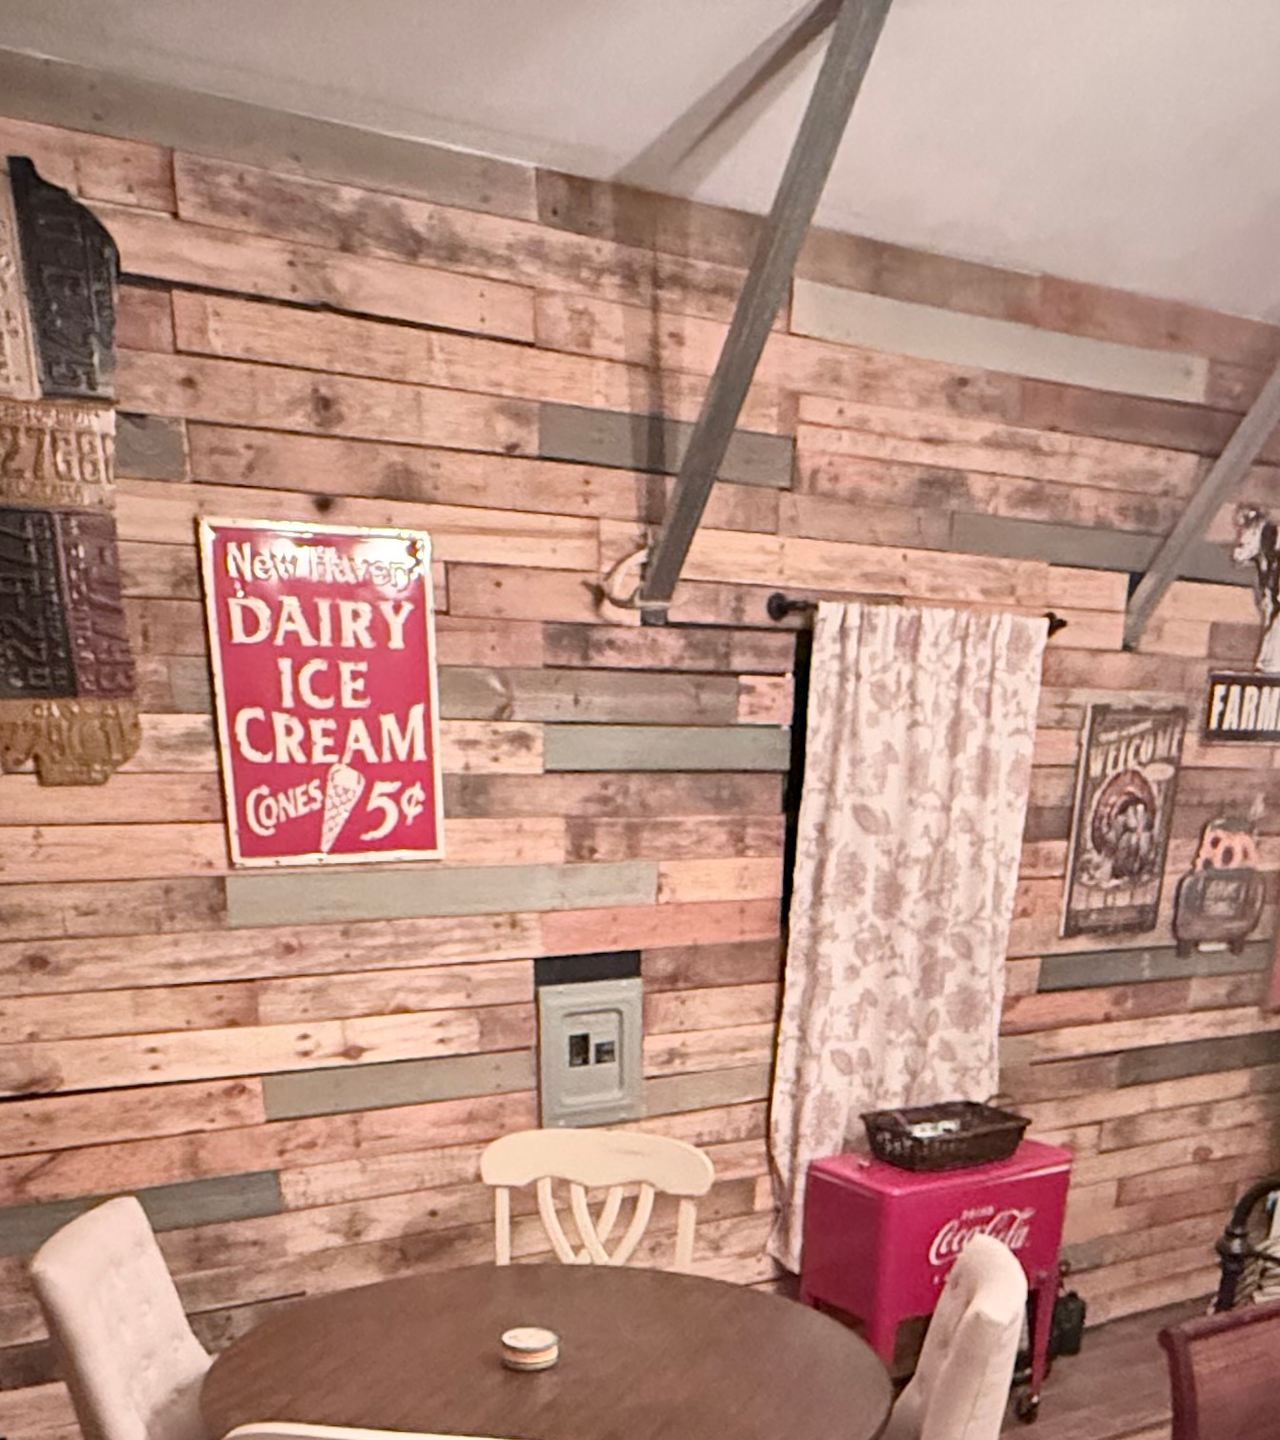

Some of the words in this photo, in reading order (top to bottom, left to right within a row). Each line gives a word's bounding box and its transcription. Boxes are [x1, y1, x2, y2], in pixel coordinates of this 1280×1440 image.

[227, 542, 298, 582] New
[228, 596, 415, 649] DAIRY
[278, 658, 371, 709] ICE
[234, 704, 428, 764] CREAM
[246, 779, 324, 836] CONES
[360, 781, 427, 841] 5¢
